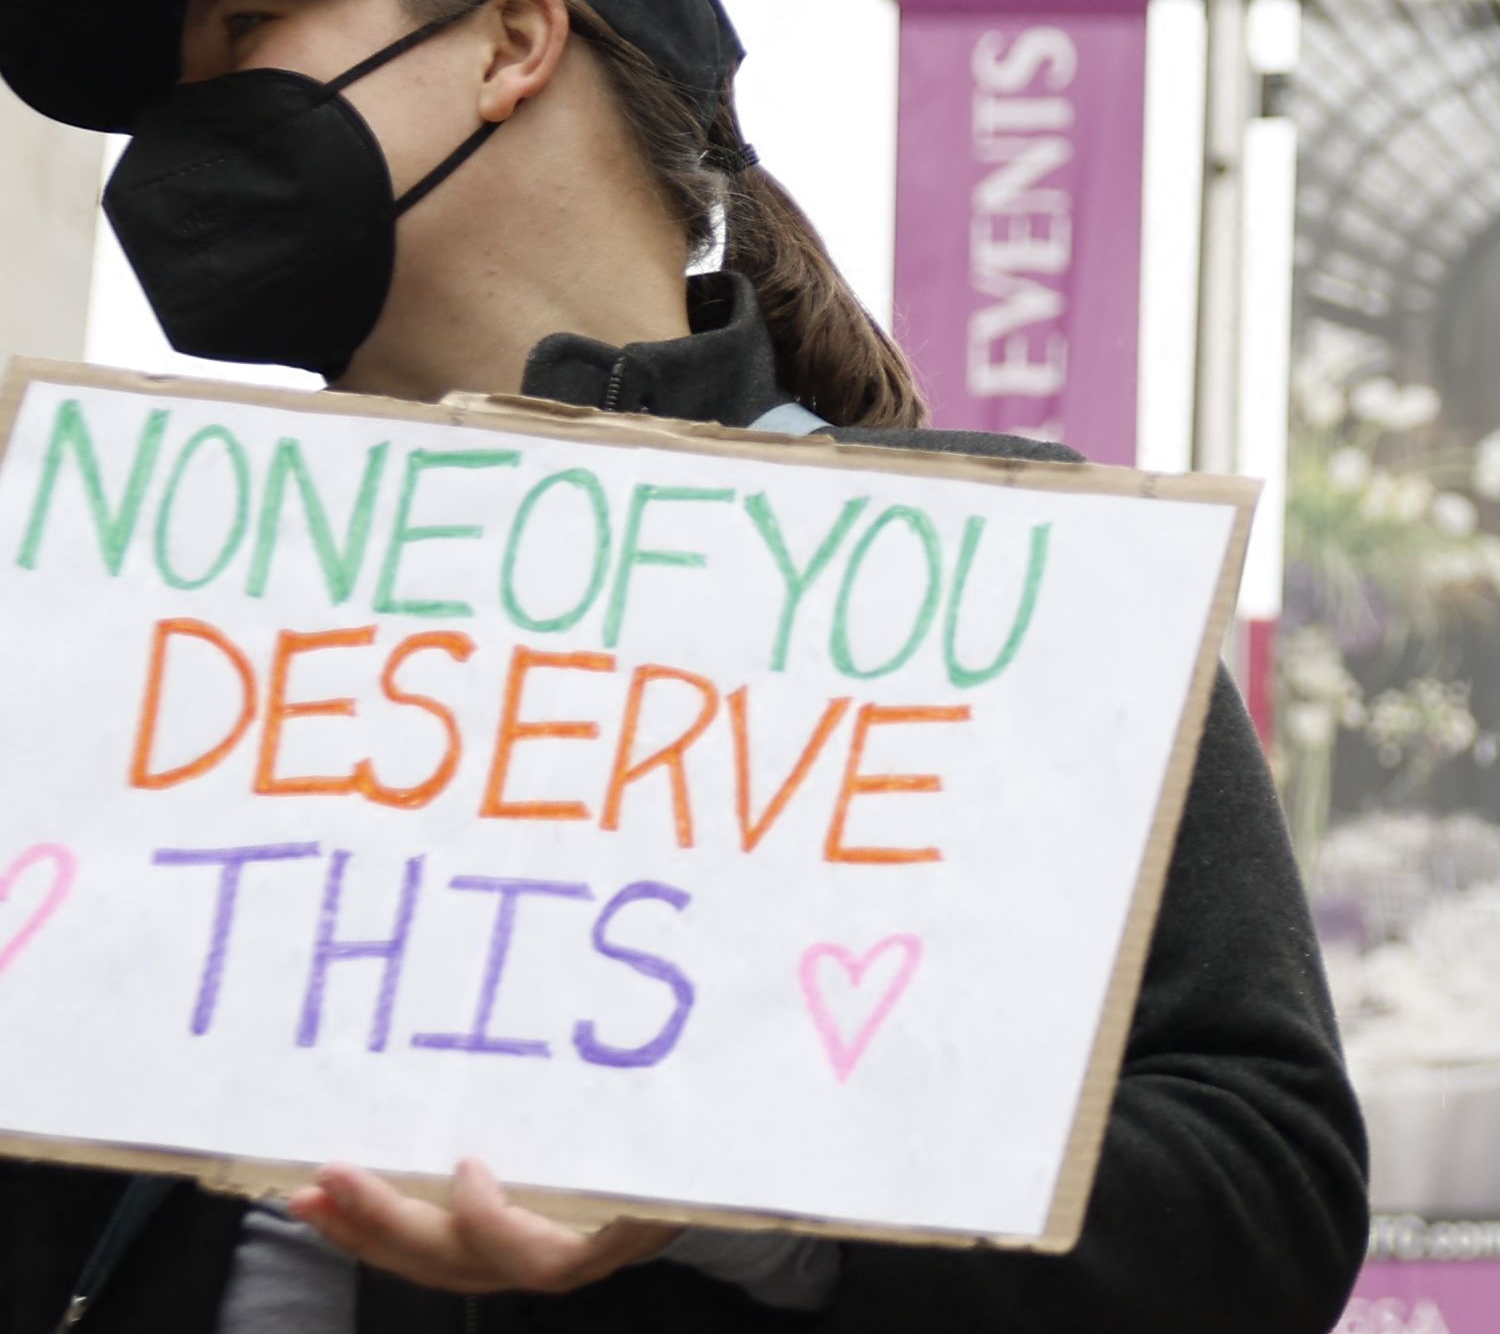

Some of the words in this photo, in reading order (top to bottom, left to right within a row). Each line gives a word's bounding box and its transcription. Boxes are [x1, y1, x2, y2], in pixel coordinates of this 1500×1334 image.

[965, 22, 1080, 399] EVENTS
[127, 616, 973, 867] DESERVE
[152, 839, 696, 1069] THIS
